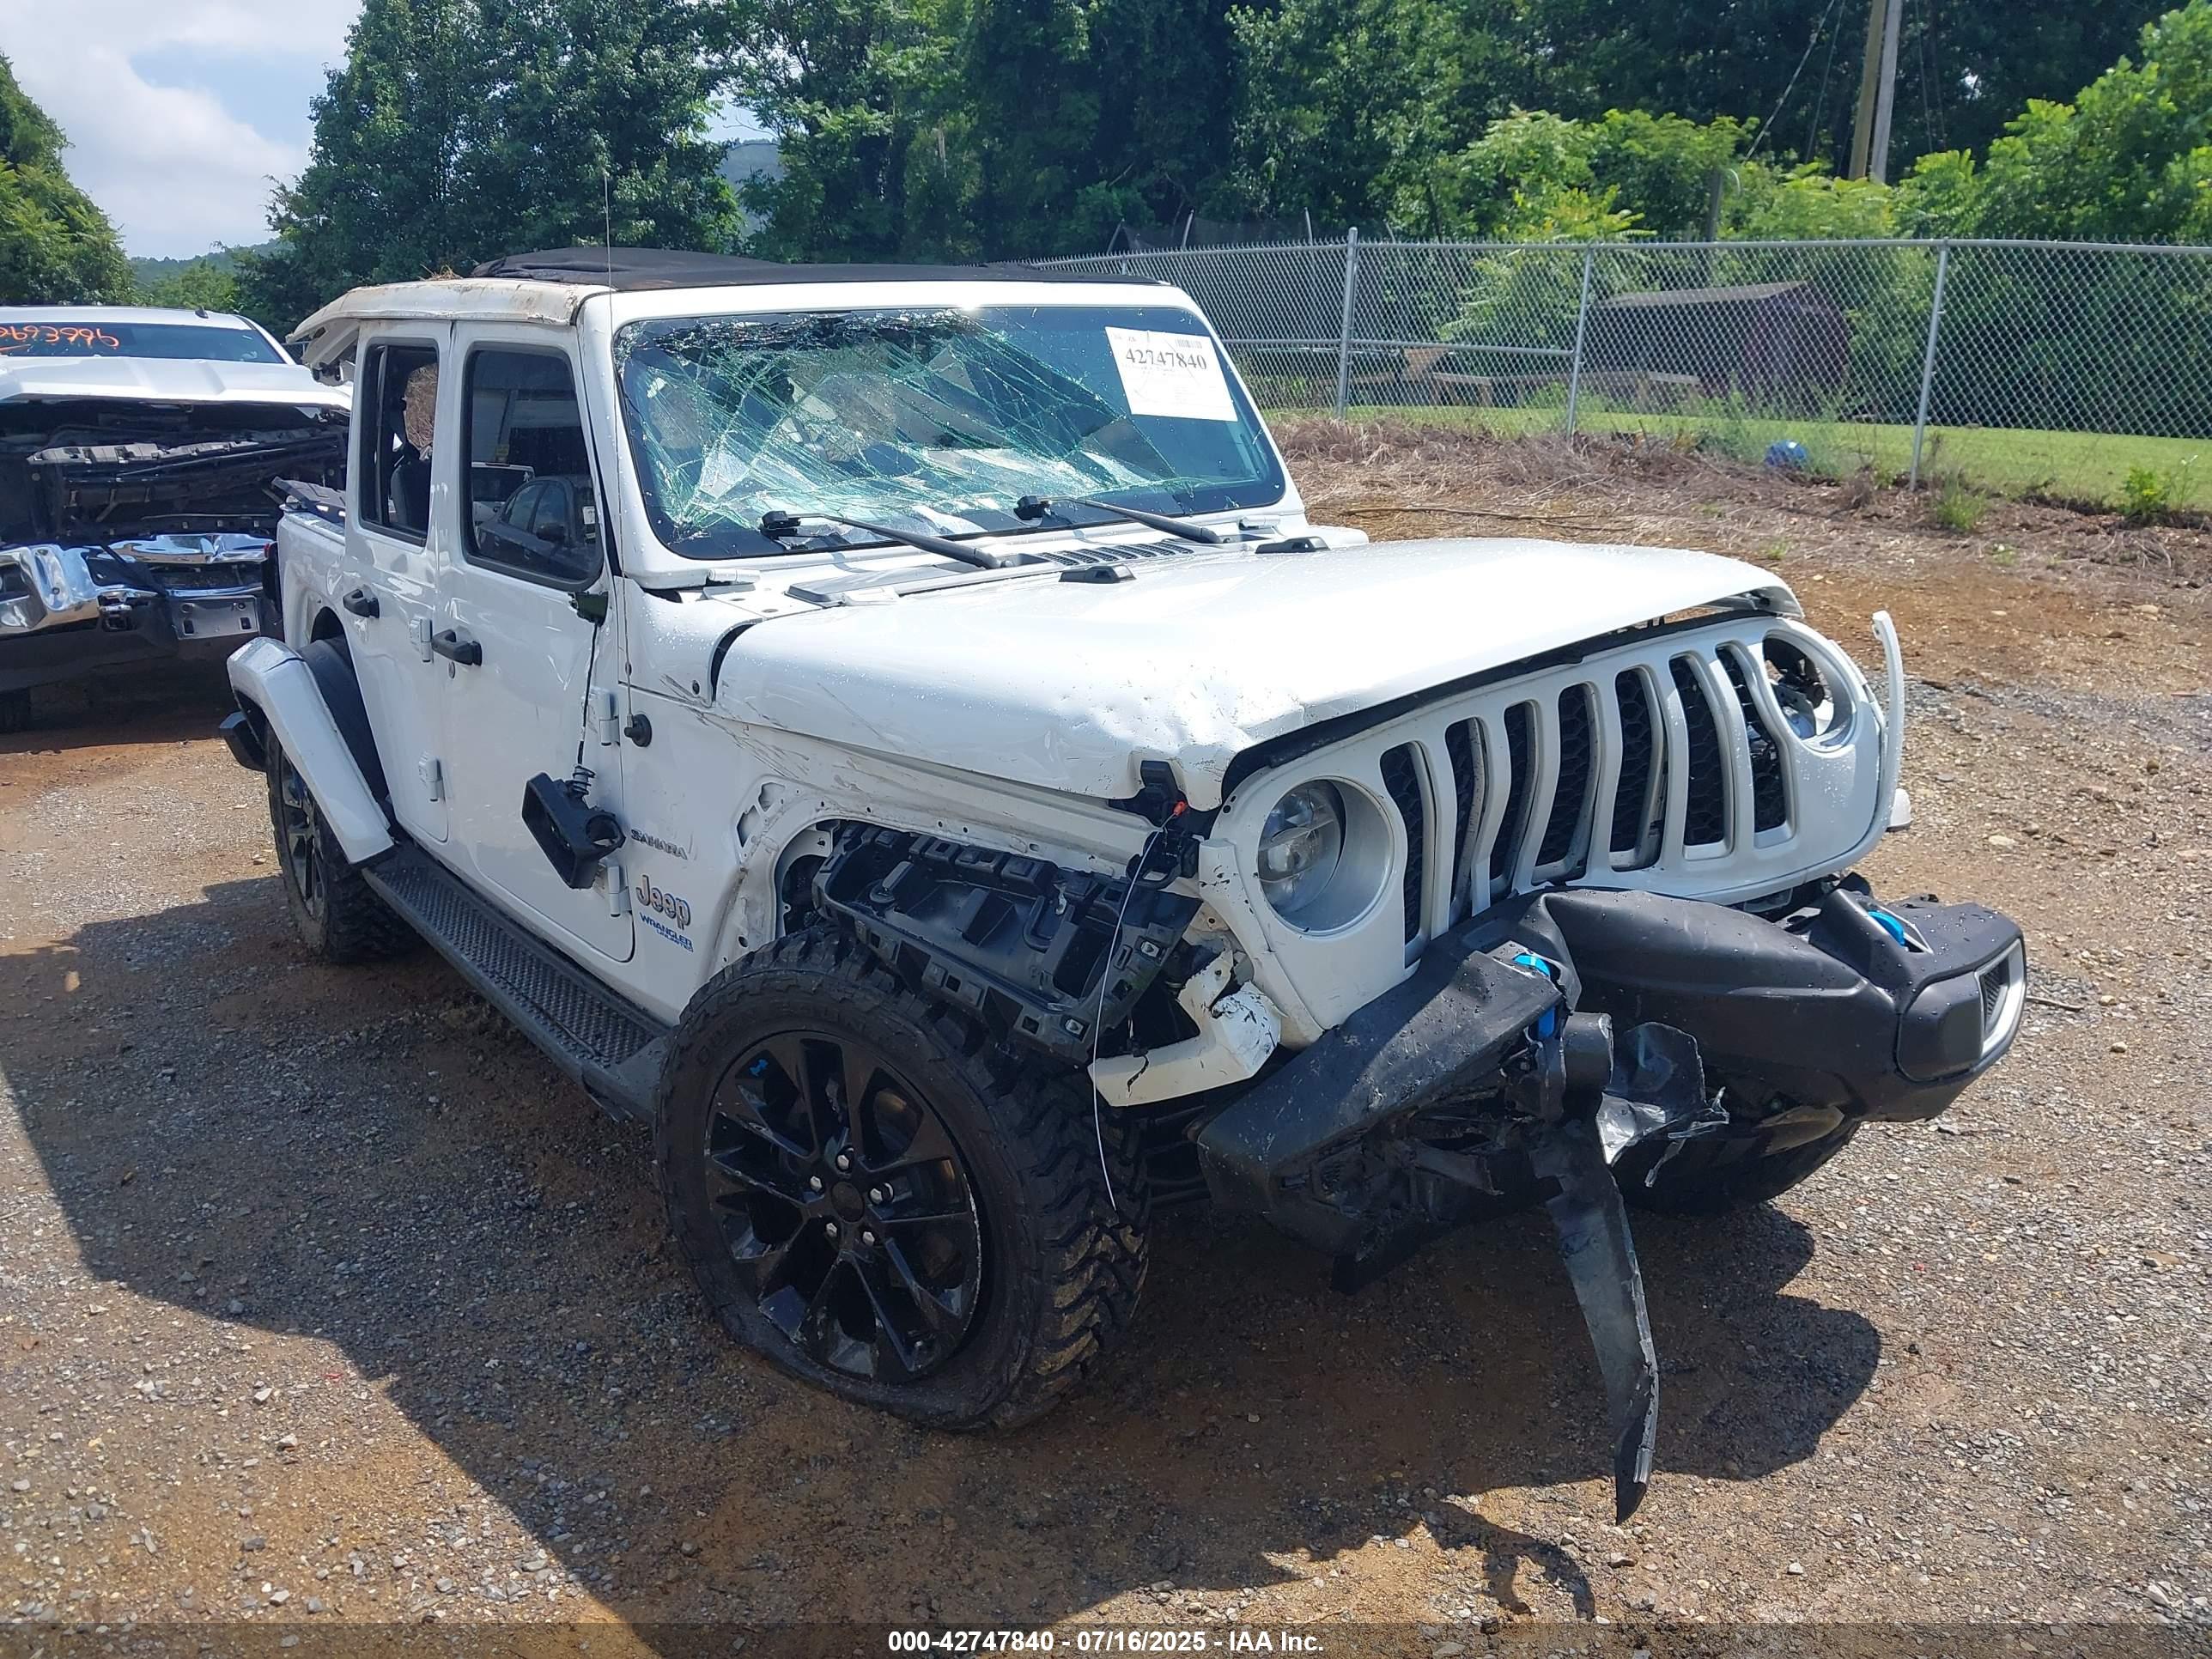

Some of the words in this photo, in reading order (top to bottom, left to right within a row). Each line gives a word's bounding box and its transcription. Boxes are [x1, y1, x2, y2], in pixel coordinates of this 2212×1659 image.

[1126, 347, 1207, 370] 42747840
[630, 829, 688, 860] SAHARA
[635, 874, 691, 931] Jeep
[639, 912, 694, 948] WRANGLER
[656, 929, 694, 953] UNLIMITED
